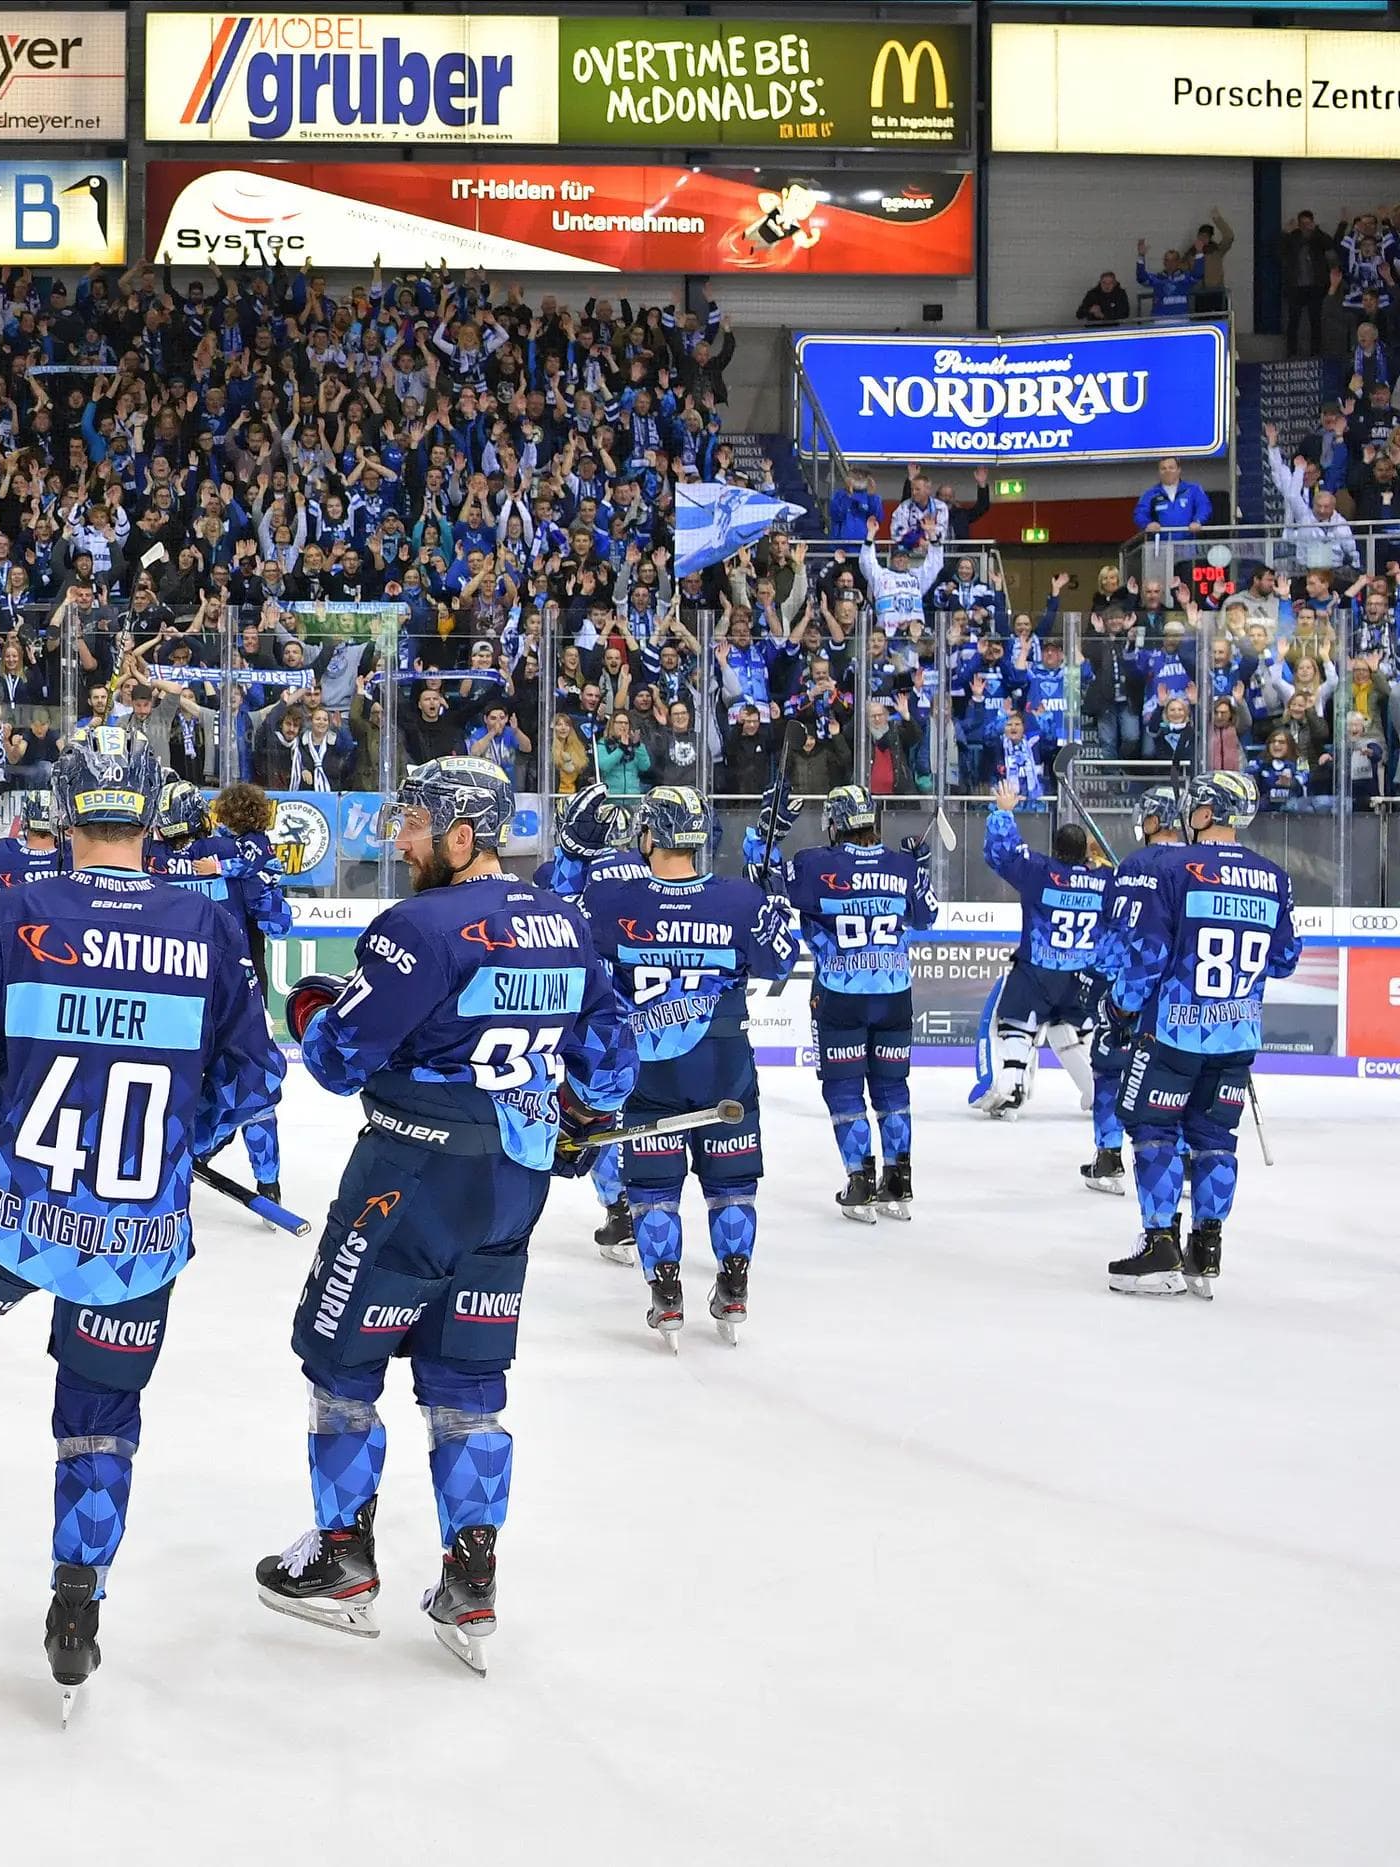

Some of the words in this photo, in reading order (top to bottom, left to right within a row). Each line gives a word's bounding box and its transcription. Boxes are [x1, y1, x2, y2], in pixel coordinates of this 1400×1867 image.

[255, 17, 374, 49] MÖBEL
[246, 37, 513, 140] gruber
[1173, 77, 1303, 108] Porsche
[1311, 80, 1400, 110] Zentr
[299, 130, 385, 140] Siemensstr.
[391, 130, 399, 140] 7
[415, 130, 513, 141] Gaimersheim
[451, 178, 555, 200] IT-Helden
[560, 178, 595, 201] für
[552, 211, 705, 234] Unternehmen
[176, 228, 306, 253] SysTec
[933, 349, 1074, 375] Privatbrauerei
[858, 370, 1149, 427] NORDBRÄU
[931, 429, 1073, 451] INGOLSTADT
[102, 766, 124, 782] 40
[444, 758, 498, 775] EDEKA
[84, 792, 137, 807] EDEKA
[69, 870, 93, 885] ERC
[95, 875, 156, 892] INGOLSTADT
[591, 864, 651, 881] SATURN
[852, 872, 907, 895] SATURN
[1070, 874, 1106, 892] SATURN
[1220, 865, 1278, 894] SATURN
[648, 881, 661, 892] ERC
[662, 883, 705, 896] INGOLSTADT
[90, 901, 143, 910] BAUER
[309, 906, 352, 919] Audi
[1059, 895, 1093, 908] REIMER
[1213, 895, 1267, 921] DETSCH
[951, 910, 994, 923] Audi
[655, 921, 733, 945] SATURN
[1050, 910, 1098, 950] 32
[82, 929, 209, 979] SATURN
[639, 949, 704, 967] SCHÜTZ
[936, 947, 972, 961] DEN
[1195, 927, 1271, 999] 89
[950, 965, 991, 979] DICH
[493, 972, 569, 1011] SULLIVAN
[56, 993, 147, 1041] OLVER
[1168, 1003, 1200, 1025] ERC
[826, 1044, 867, 1060] CINQUE
[1121, 1049, 1150, 1112] SATURN
[15, 1055, 172, 1200] 40
[370, 1108, 450, 1145] BAUER
[632, 1134, 684, 1153] CINQUE
[703, 1133, 758, 1153] CINQUE
[27, 1200, 187, 1257] INGOLSTADT
[314, 1231, 368, 1340] SATURN
[455, 1291, 521, 1317] CINQUE
[78, 1308, 161, 1347] CINQUE
